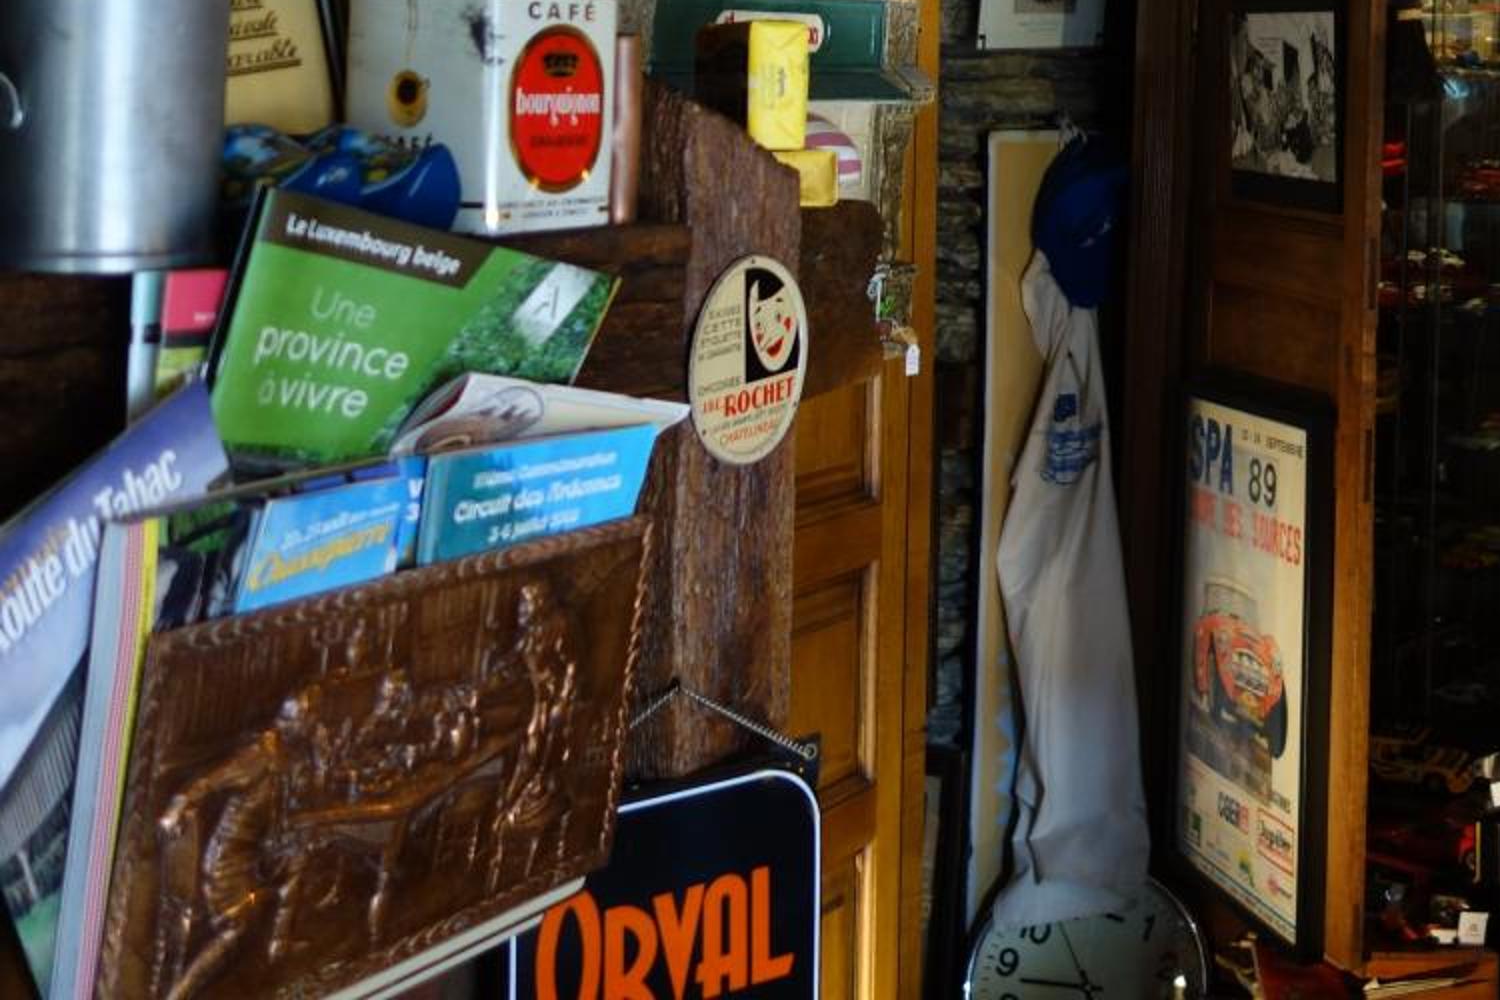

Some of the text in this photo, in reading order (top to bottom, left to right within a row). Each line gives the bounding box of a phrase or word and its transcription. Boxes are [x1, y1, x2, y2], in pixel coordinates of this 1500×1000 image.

[527, 0, 599, 22] CAFÉ
[286, 212, 463, 279] Le Luxembourg belge
[311, 285, 377, 331] Une
[256, 322, 410, 383] province
[257, 379, 370, 421] à vivre
[724, 376, 794, 417] ROCHET
[1190, 414, 1233, 495] SPA
[1248, 458, 1277, 507] 89
[0, 548, 67, 646] oute
[93, 450, 181, 519] Tabac
[534, 865, 796, 1000] ORVAL
[996, 948, 1019, 977] 9
